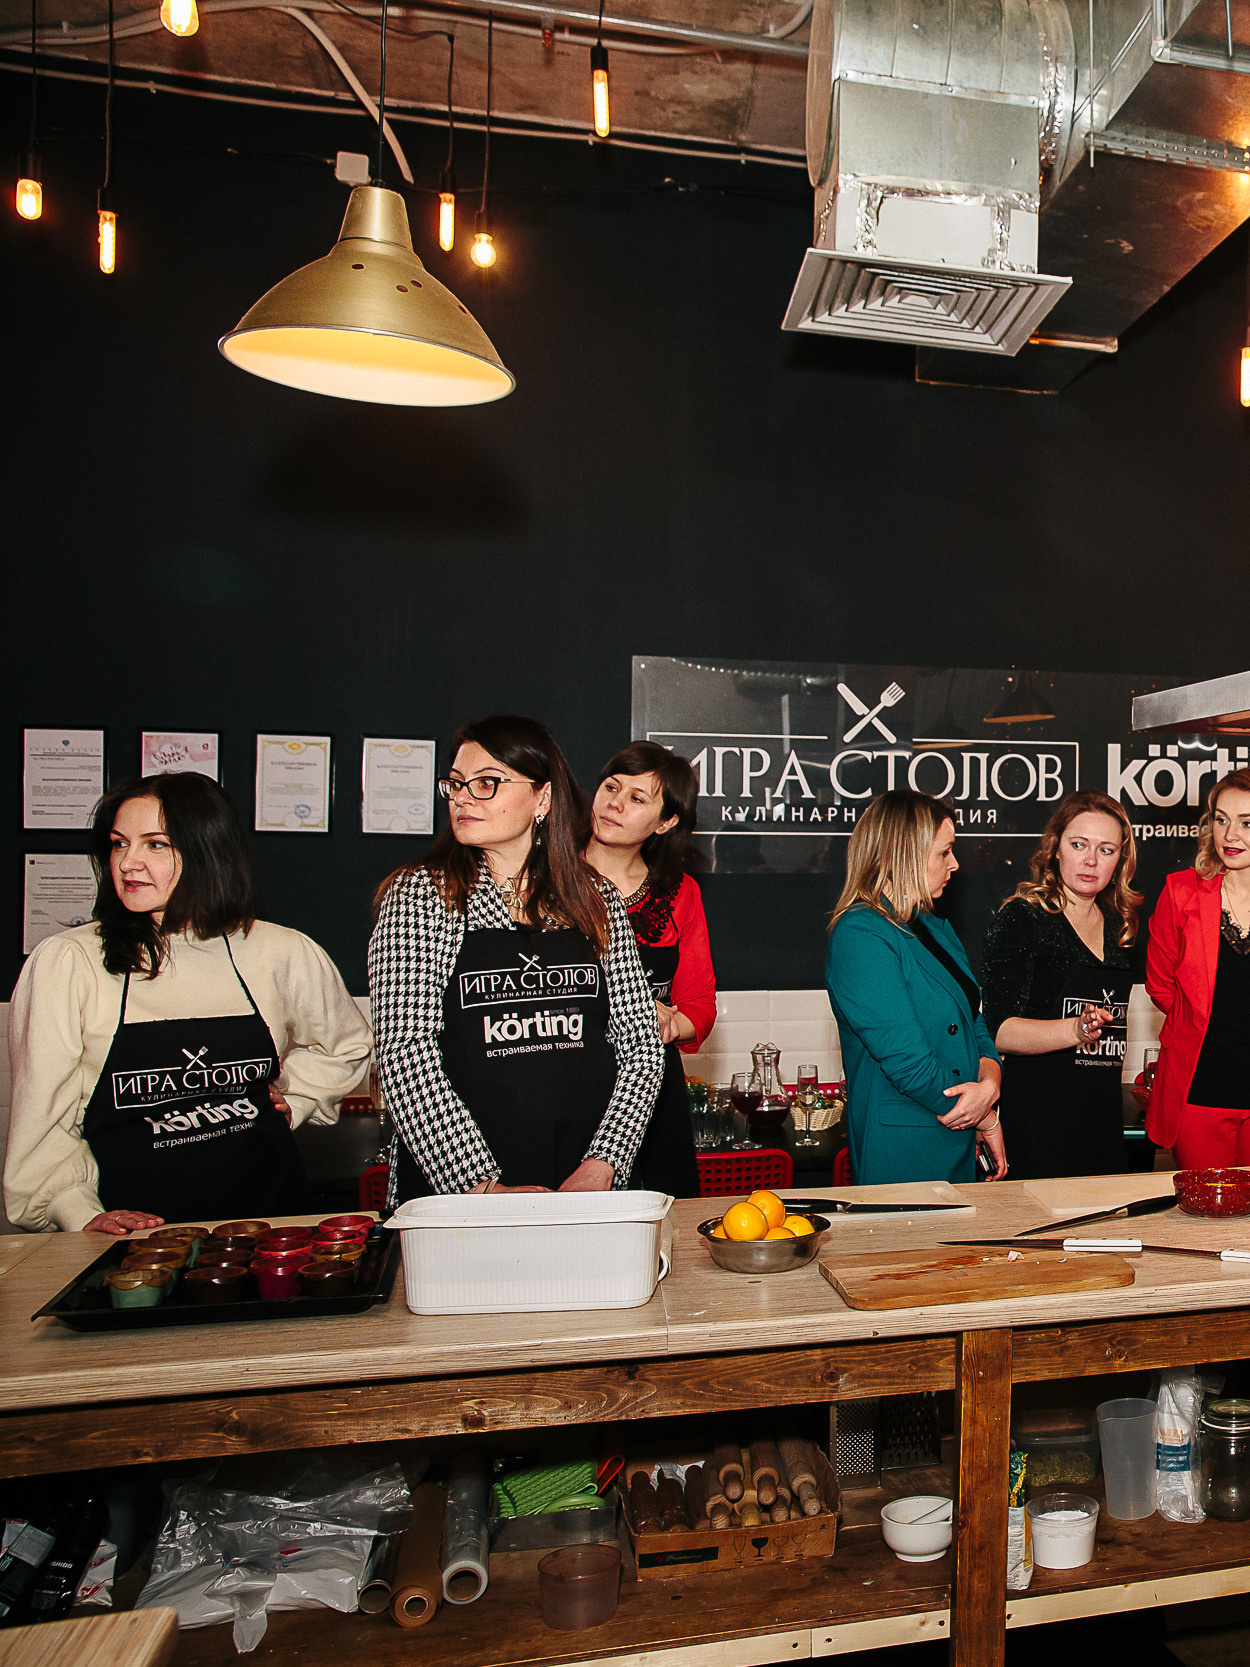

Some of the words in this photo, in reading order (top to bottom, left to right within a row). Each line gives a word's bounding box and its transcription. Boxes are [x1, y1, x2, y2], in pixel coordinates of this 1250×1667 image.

[829, 749, 1064, 802] СТОЛОВ
[464, 974, 517, 995] ИГРА
[520, 968, 596, 989] СТОЛОВ
[484, 989, 543, 1000] КУЛИНАРНАЯ
[546, 987, 578, 995] СТУДИЯ
[483, 1010, 584, 1044] körting
[486, 1042, 553, 1058] встраиваемая
[554, 1041, 585, 1050] техника
[117, 1073, 178, 1095] ИГРА
[182, 1063, 268, 1089] СТОЛОВ
[143, 1097, 259, 1135] körting
[153, 1128, 227, 1149] встраиваемая
